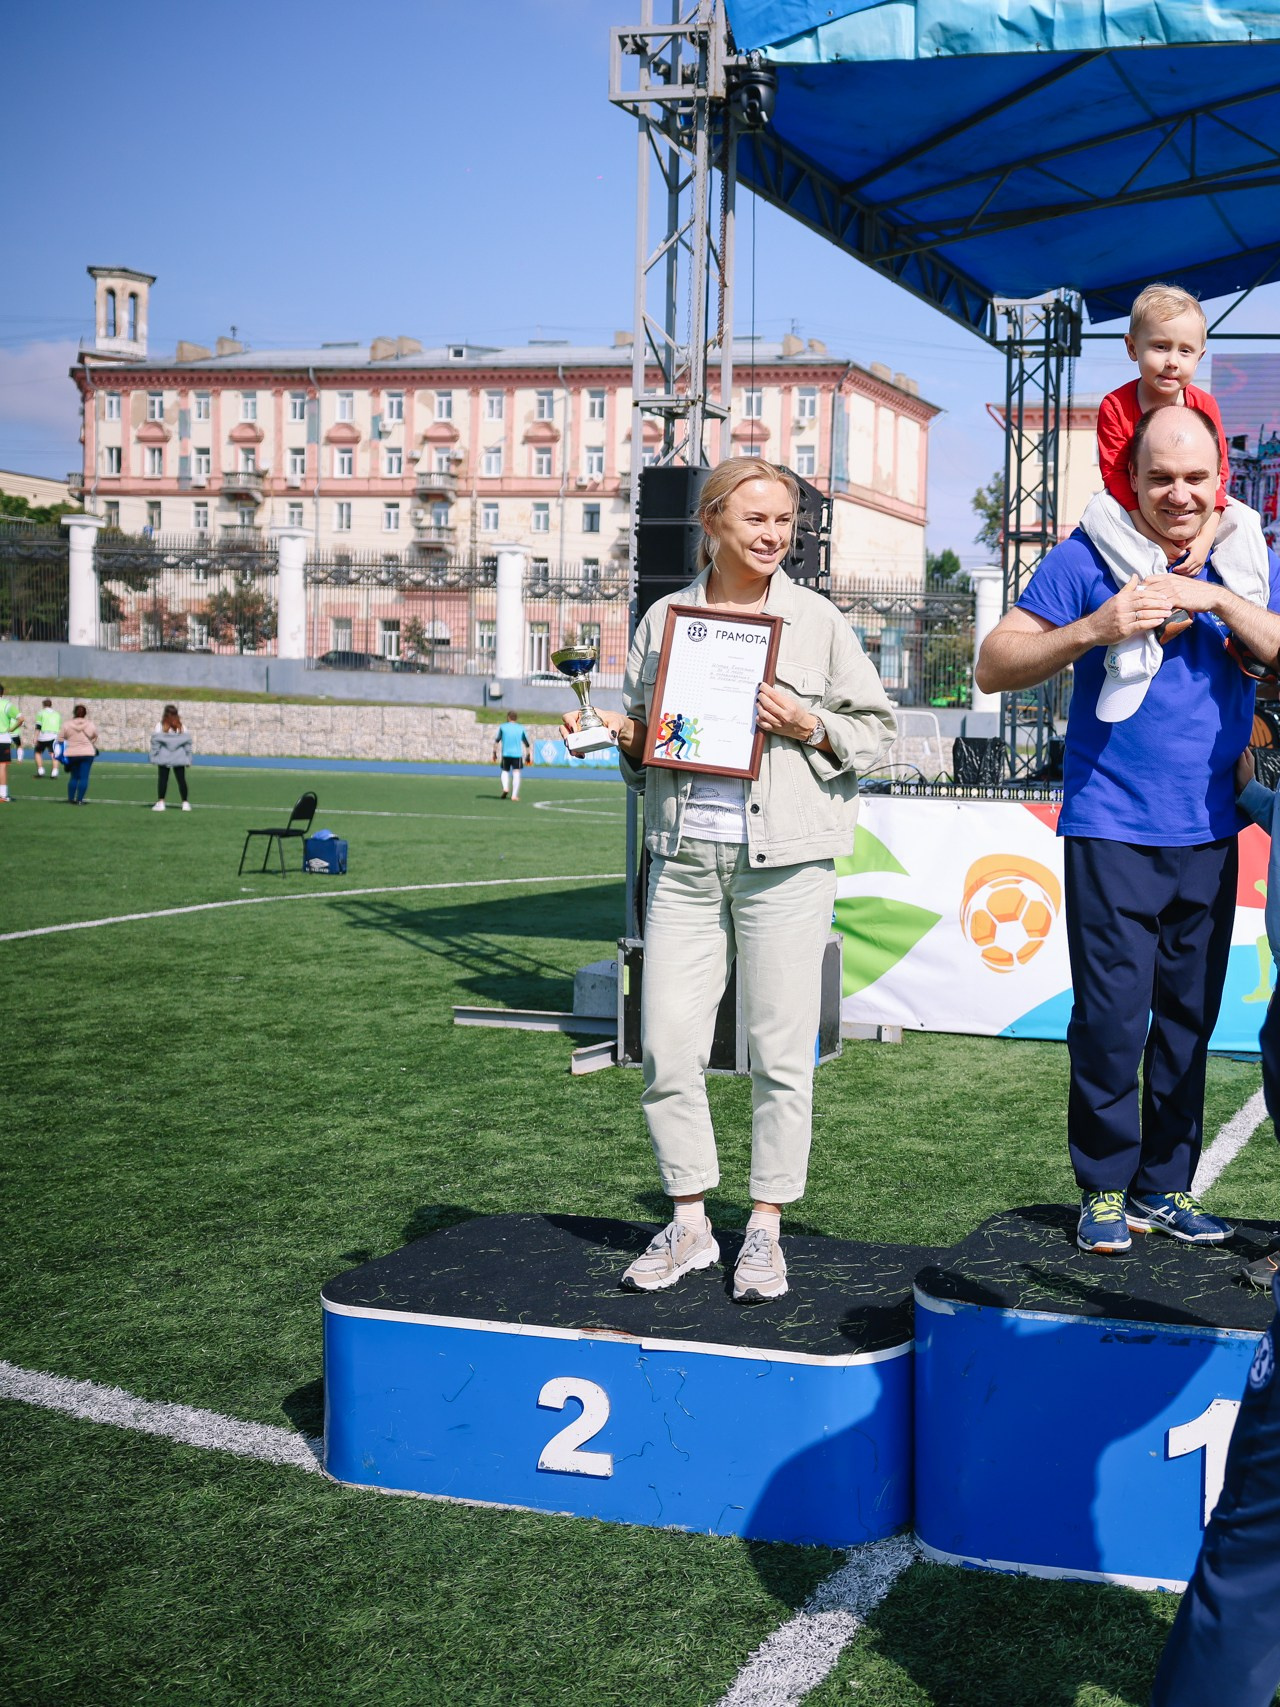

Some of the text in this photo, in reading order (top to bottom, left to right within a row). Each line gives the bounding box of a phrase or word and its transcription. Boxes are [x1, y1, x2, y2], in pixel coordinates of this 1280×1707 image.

[715, 629, 768, 645] ГРАМОТА
[537, 1376, 614, 1478] 2
[1168, 1398, 1243, 1528] 1
